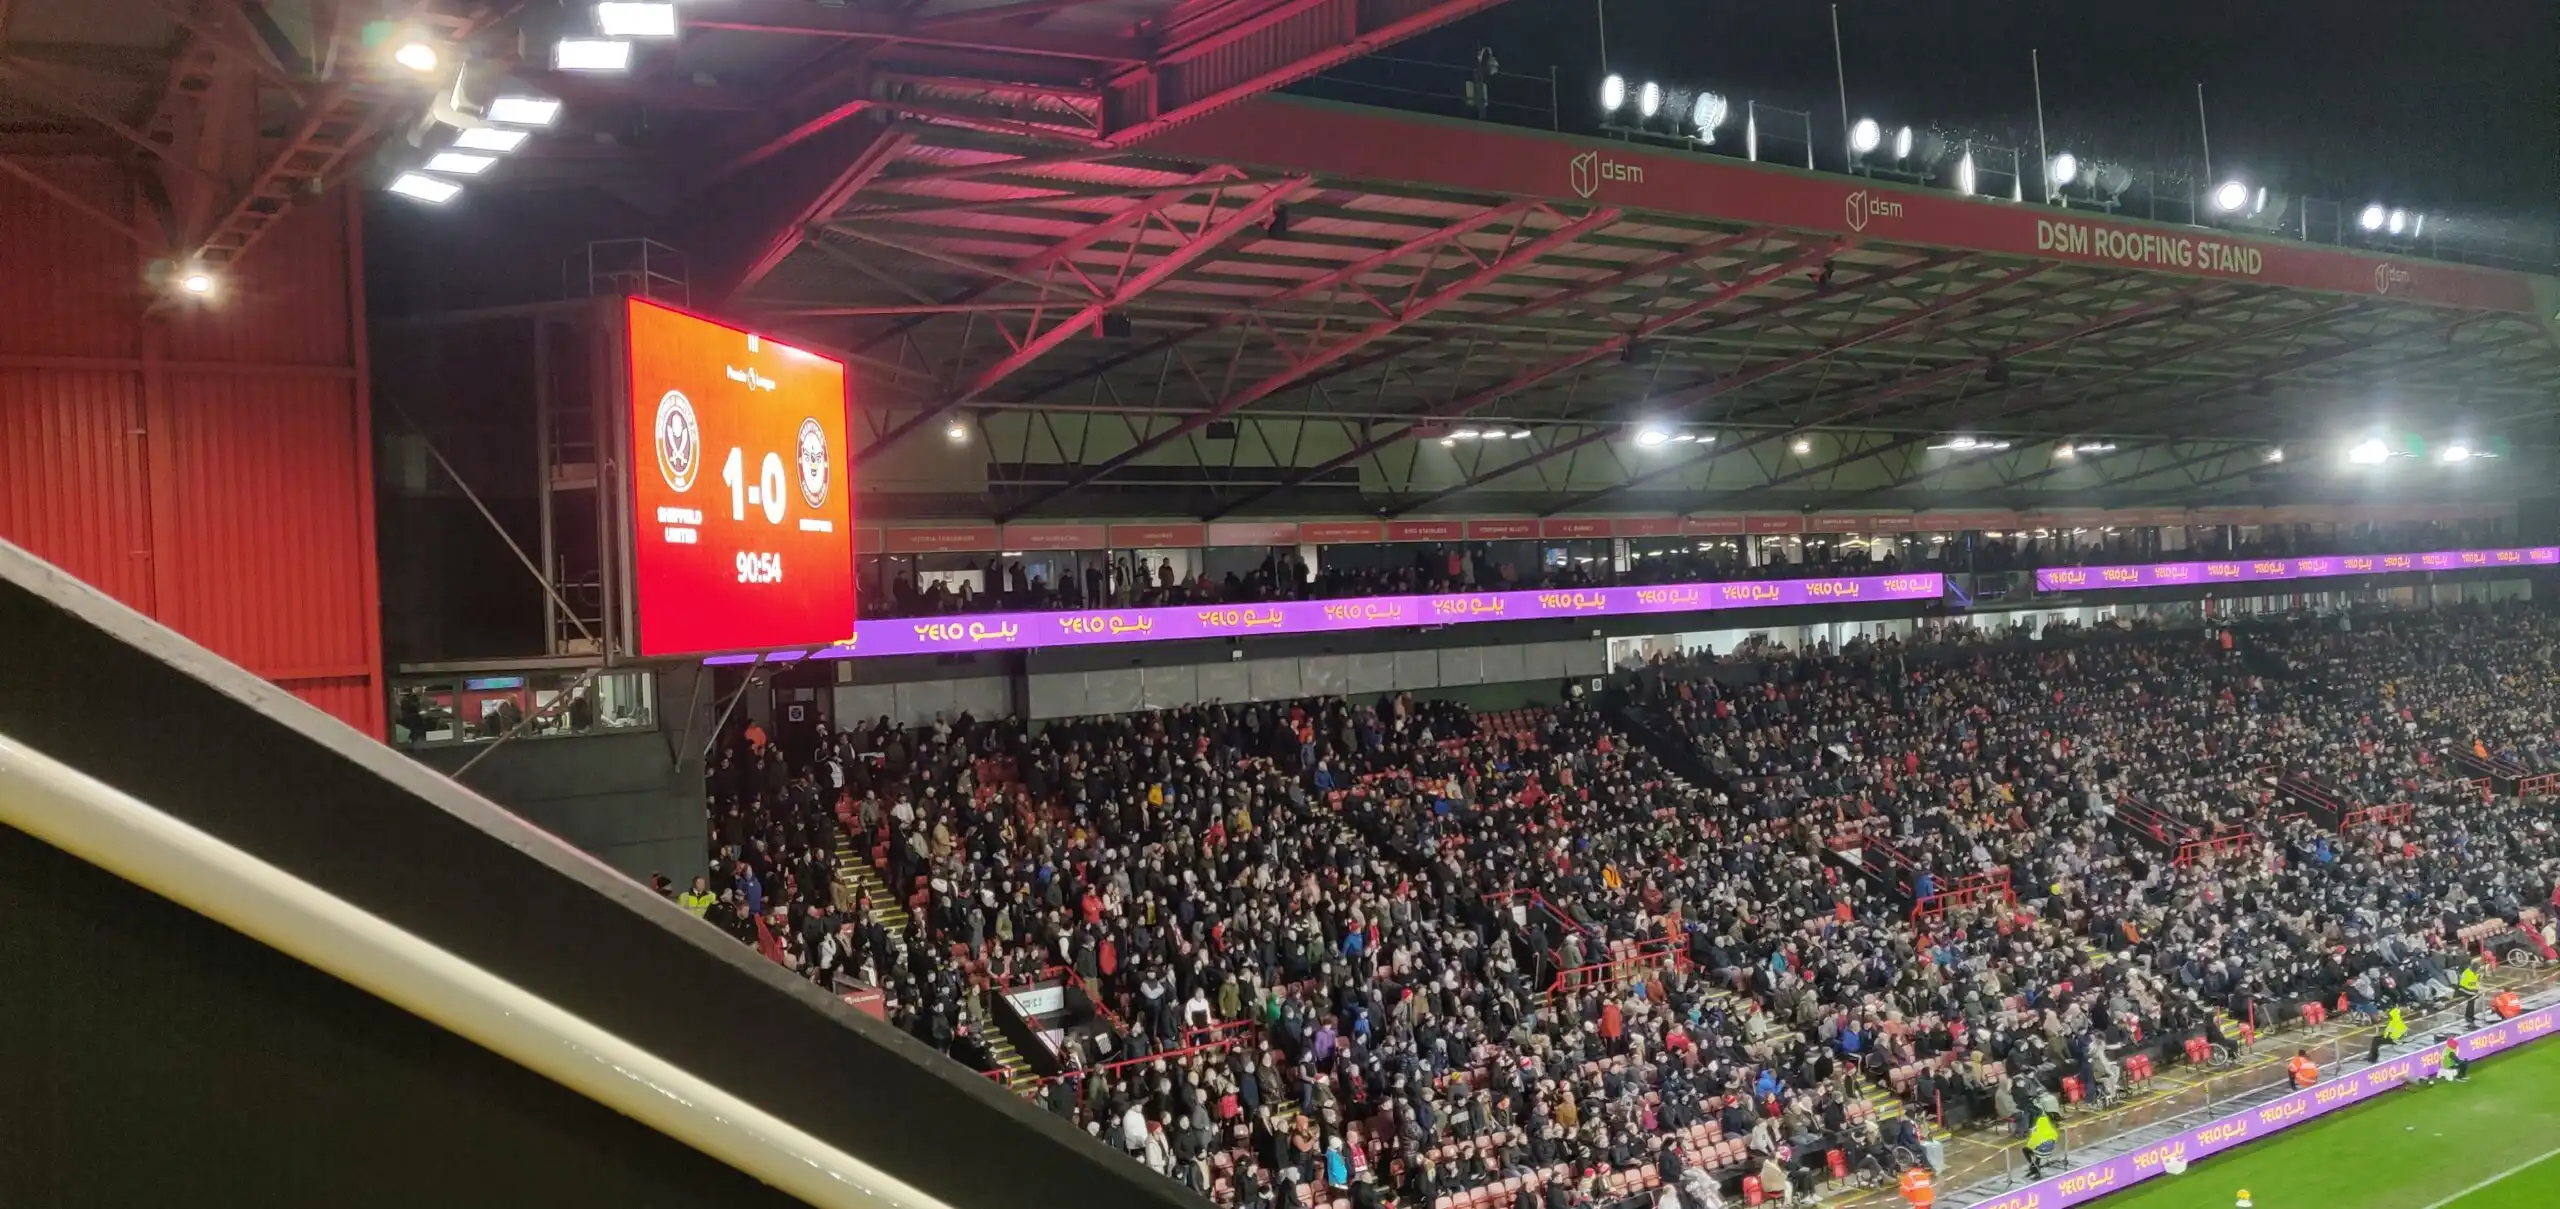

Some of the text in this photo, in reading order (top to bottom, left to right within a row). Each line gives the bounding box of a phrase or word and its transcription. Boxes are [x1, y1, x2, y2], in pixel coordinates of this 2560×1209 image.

[1601, 159, 1644, 184] dsm
[1870, 196, 1903, 218] dsm
[2037, 219, 2263, 275] DSM ROOFING STAND
[722, 446, 787, 525] 1-0
[736, 551, 783, 584] 90:54
[1636, 590, 1667, 605] YELO
[1722, 585, 1750, 600] YELO
[1806, 582, 1833, 597] YELO
[1432, 599, 1468, 615] YELO
[1538, 593, 1571, 609] YELO
[1198, 610, 1240, 628] YELO
[1323, 603, 1362, 620] YELO
[914, 622, 964, 642] YELO
[1059, 616, 1105, 634] YELO
[2196, 1127, 2222, 1146] YELO
[2133, 1150, 2158, 1171] YELO
[2058, 1175, 2085, 1197] YELO
